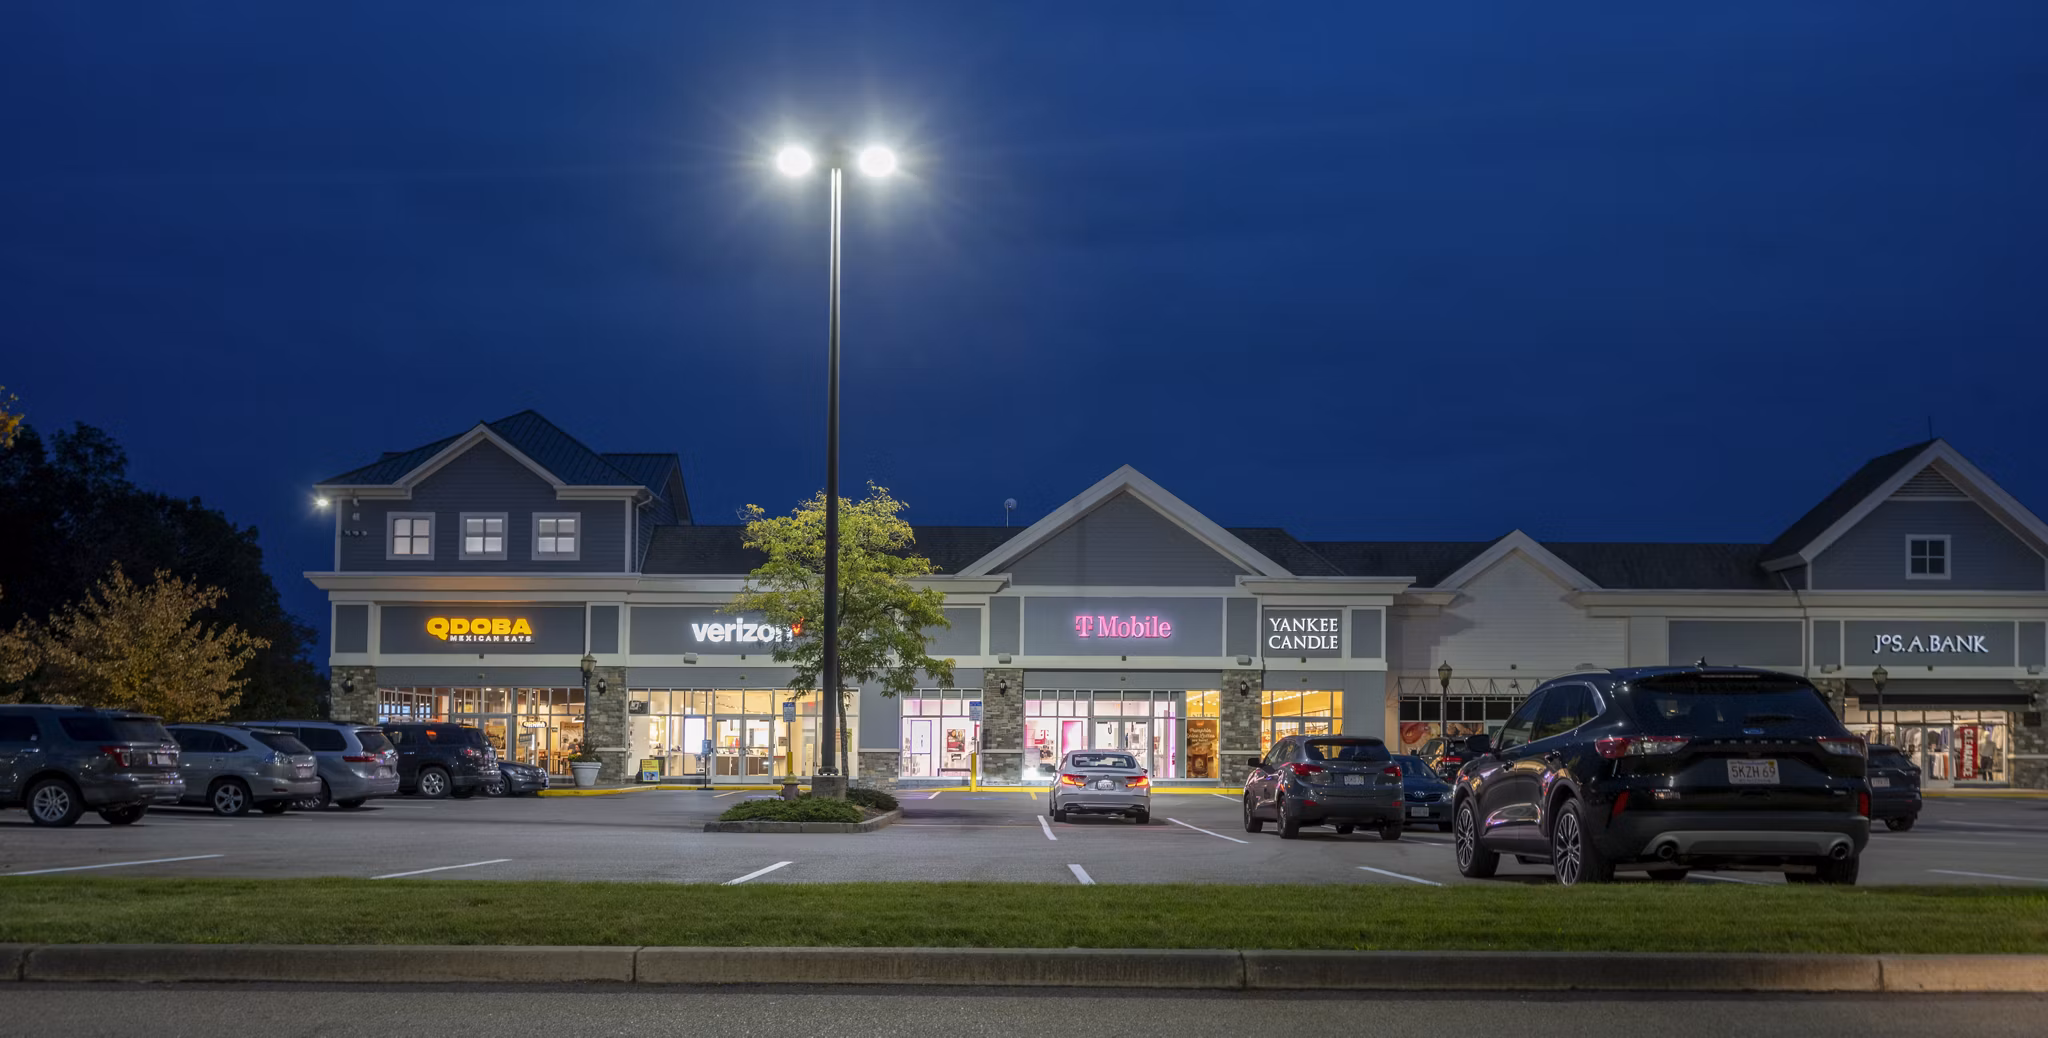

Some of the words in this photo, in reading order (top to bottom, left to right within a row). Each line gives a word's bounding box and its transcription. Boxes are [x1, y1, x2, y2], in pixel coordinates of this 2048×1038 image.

[427, 617, 533, 640] QDOBA
[1097, 615, 1172, 638] Mobile
[1268, 617, 1339, 632] YANKEE
[1268, 635, 1339, 650] CANDLE
[1963, 728, 1974, 777] CLEARANCE
[1731, 766, 1760, 778] 5KZH
[1762, 766, 1776, 778] 69
